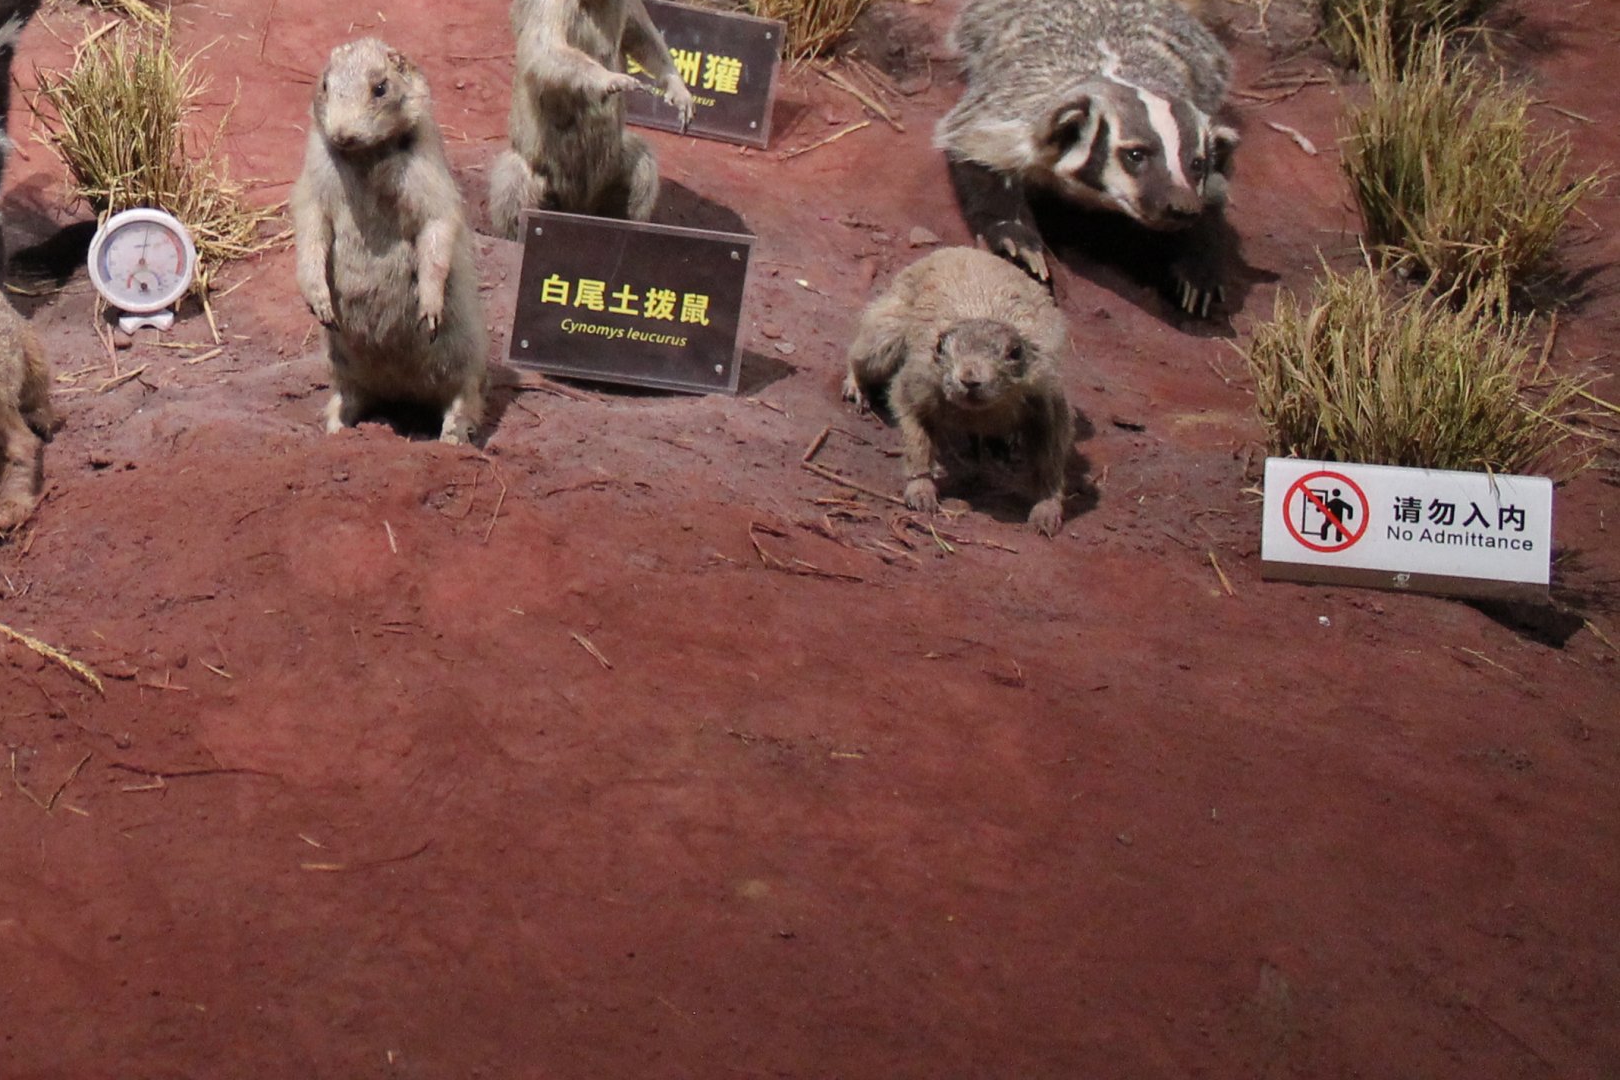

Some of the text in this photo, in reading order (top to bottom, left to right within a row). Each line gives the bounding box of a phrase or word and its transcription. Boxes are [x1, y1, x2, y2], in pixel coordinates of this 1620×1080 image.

[540, 273, 710, 326] 白尾土拨鼠
[560, 318, 688, 347] Cynomys leucurus
[1393, 496, 1526, 532] 请勿入内
[1386, 525, 1534, 552] No Admittance
